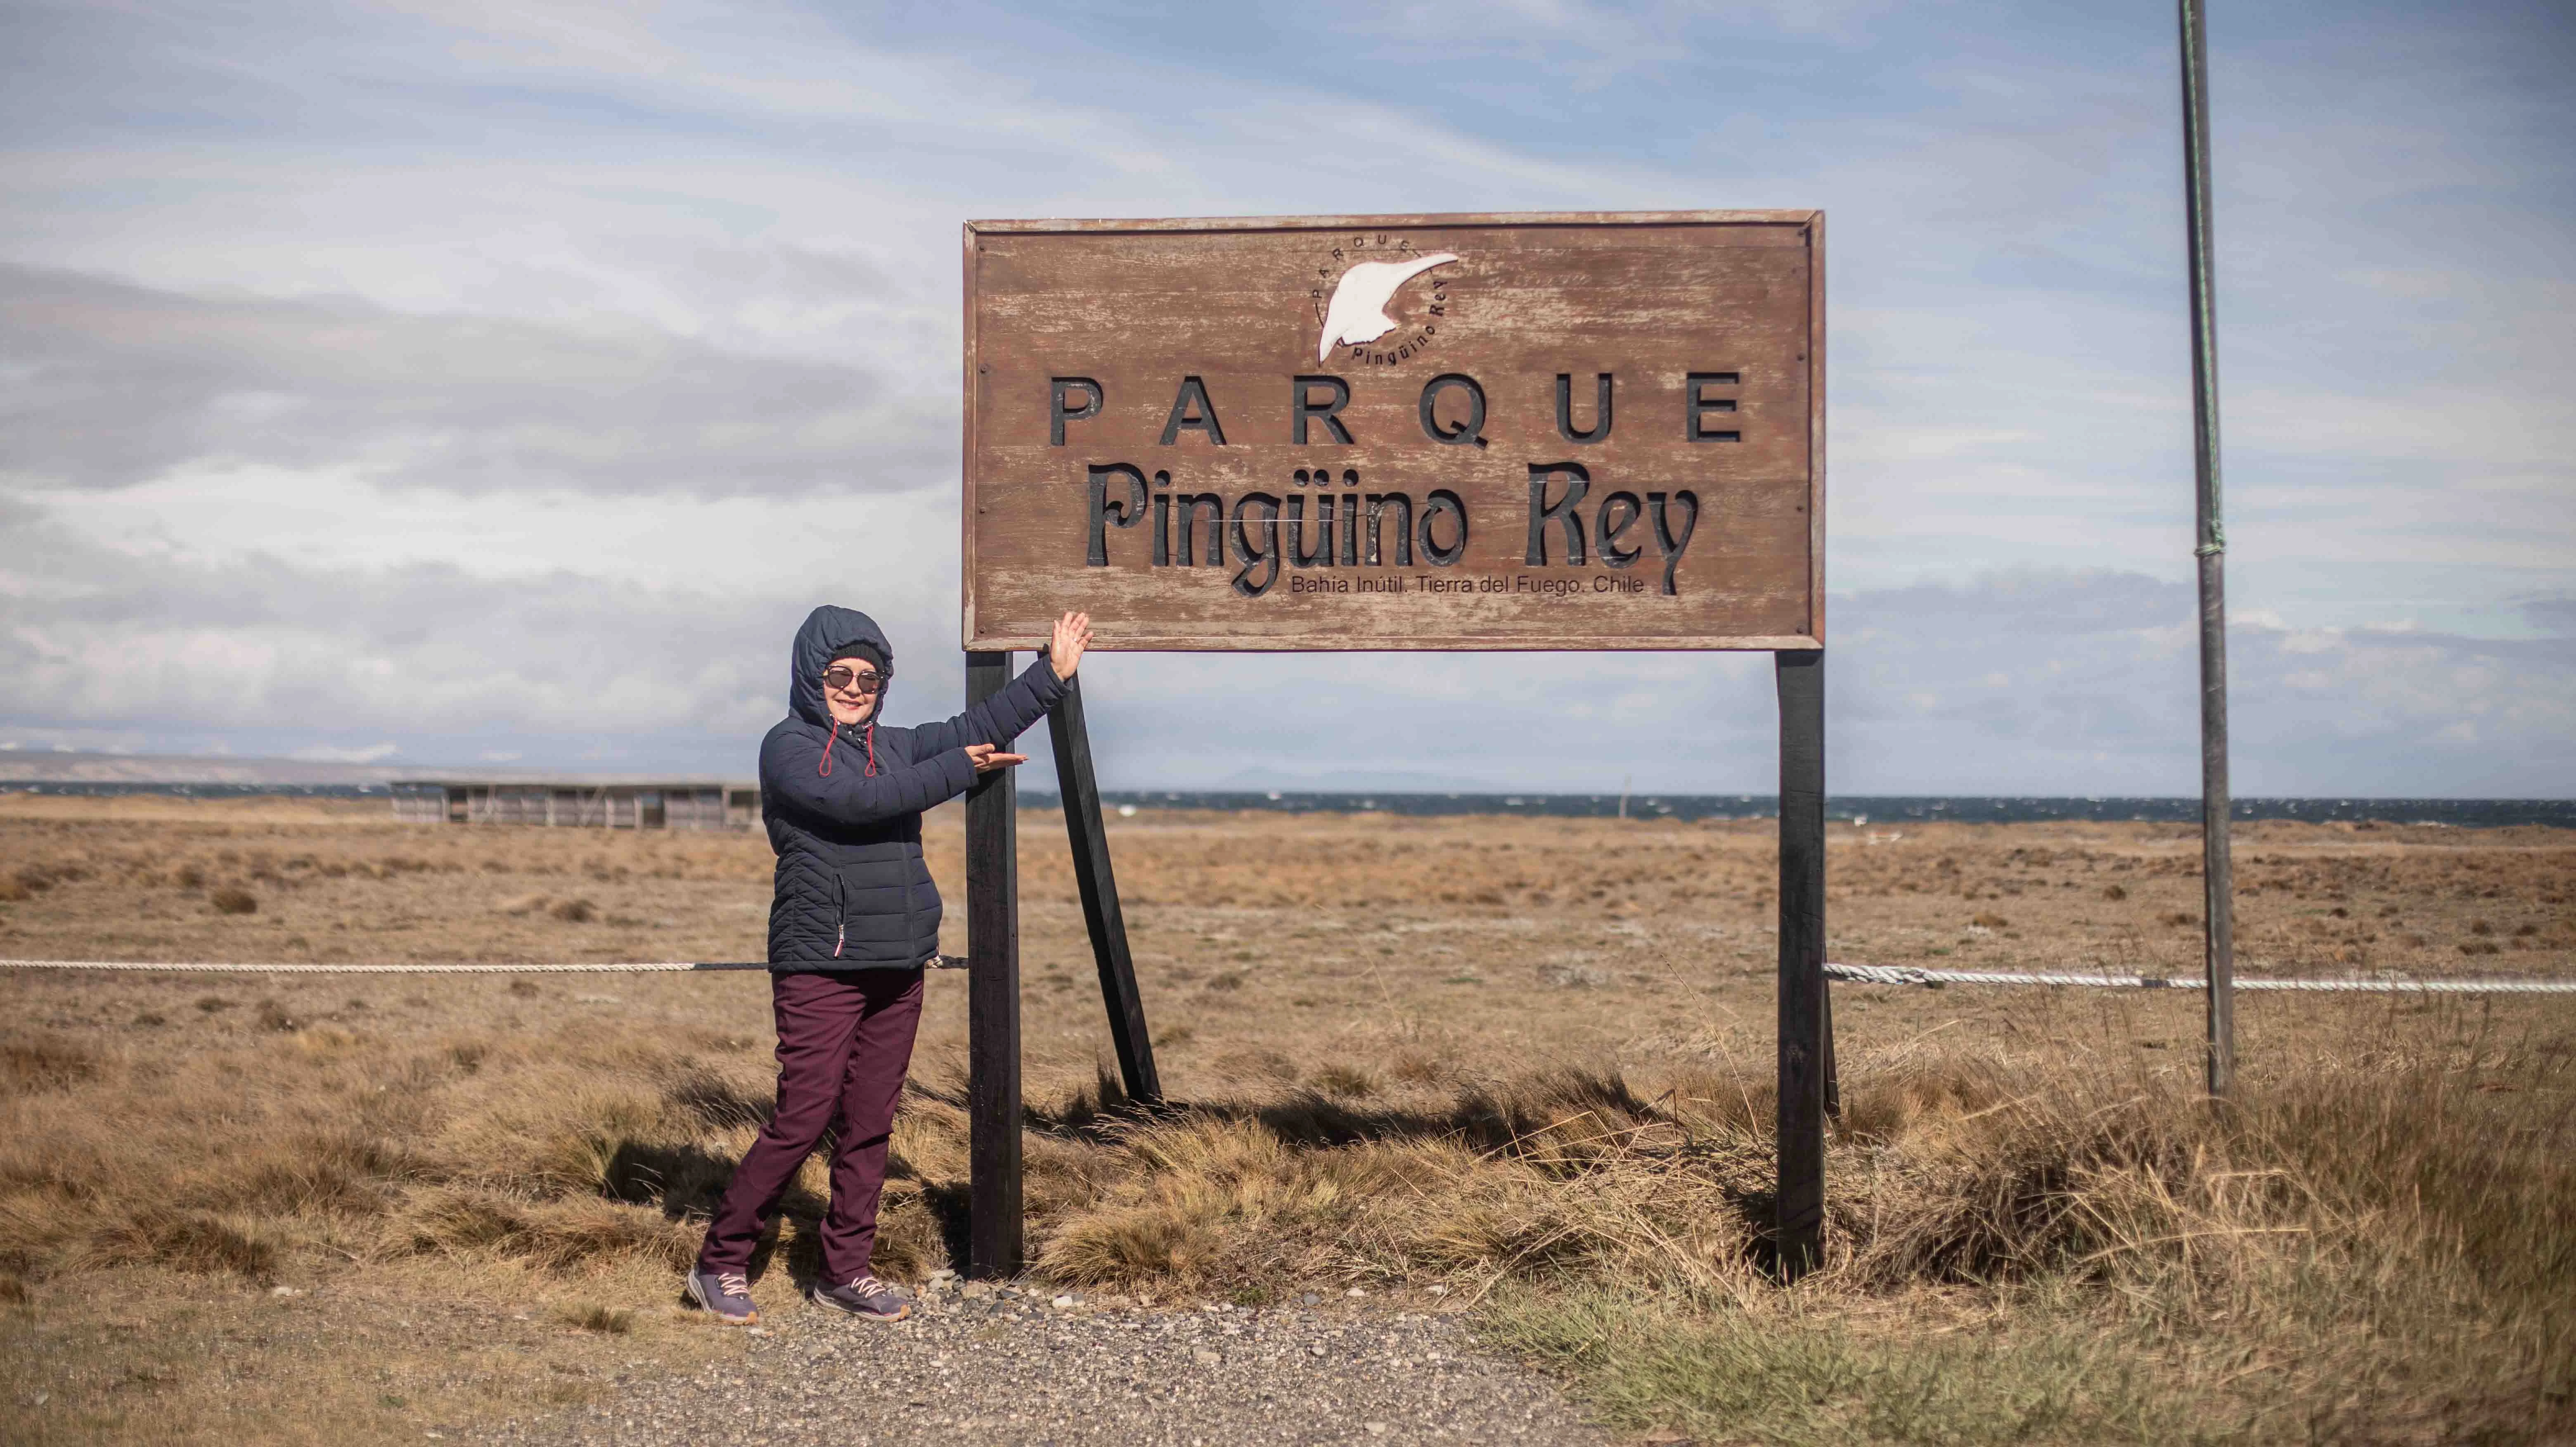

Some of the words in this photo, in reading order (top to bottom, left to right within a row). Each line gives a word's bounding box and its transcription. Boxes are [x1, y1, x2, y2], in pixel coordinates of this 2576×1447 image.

[1312, 234, 1410, 299] PARQUE
[1351, 325, 1435, 366] Pingüino
[1050, 372, 1741, 450] PARQUE
[1087, 462, 1468, 597] Pingüino
[1525, 461, 1699, 595] Rey
[1292, 576, 1348, 593] Bahía
[1357, 576, 1407, 593] Inútil.
[1416, 576, 1473, 593] Tierra
[1480, 576, 1508, 593] del
[1517, 576, 1585, 597] Fuego.
[1593, 575, 1644, 593] Chile
